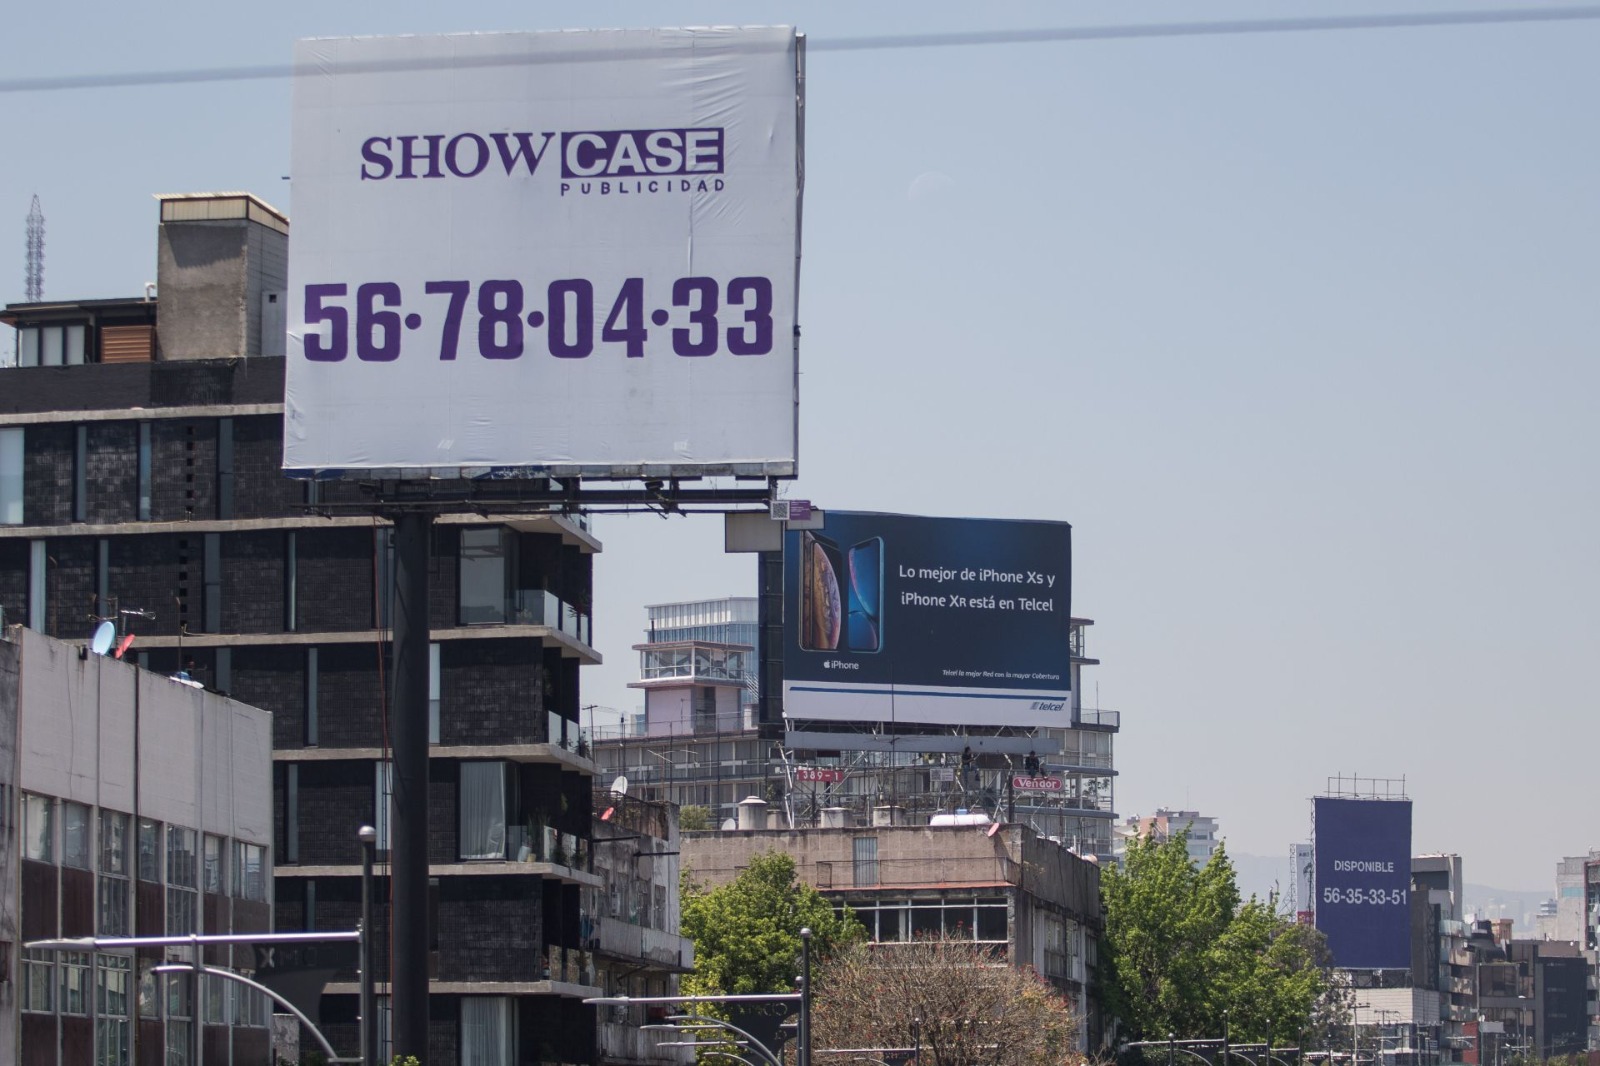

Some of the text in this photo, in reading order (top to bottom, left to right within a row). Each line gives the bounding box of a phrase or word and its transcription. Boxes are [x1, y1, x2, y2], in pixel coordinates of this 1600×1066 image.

[560, 179, 725, 197] PUBLICIDAD
[899, 564, 916, 578] Lo
[918, 567, 958, 583] mejor
[960, 568, 976, 581] de
[979, 568, 1024, 584] iPhone
[1047, 574, 1056, 588] y
[901, 591, 947, 607] iPhone
[969, 595, 996, 609] está
[999, 599, 1015, 610] en
[1018, 597, 1054, 612] Telcel
[831, 660, 860, 670] iPhone
[1018, 778, 1057, 789] Vendor
[1334, 860, 1394, 873] DISPONIBLE
[1323, 887, 1407, 905] 56-35-33-51
